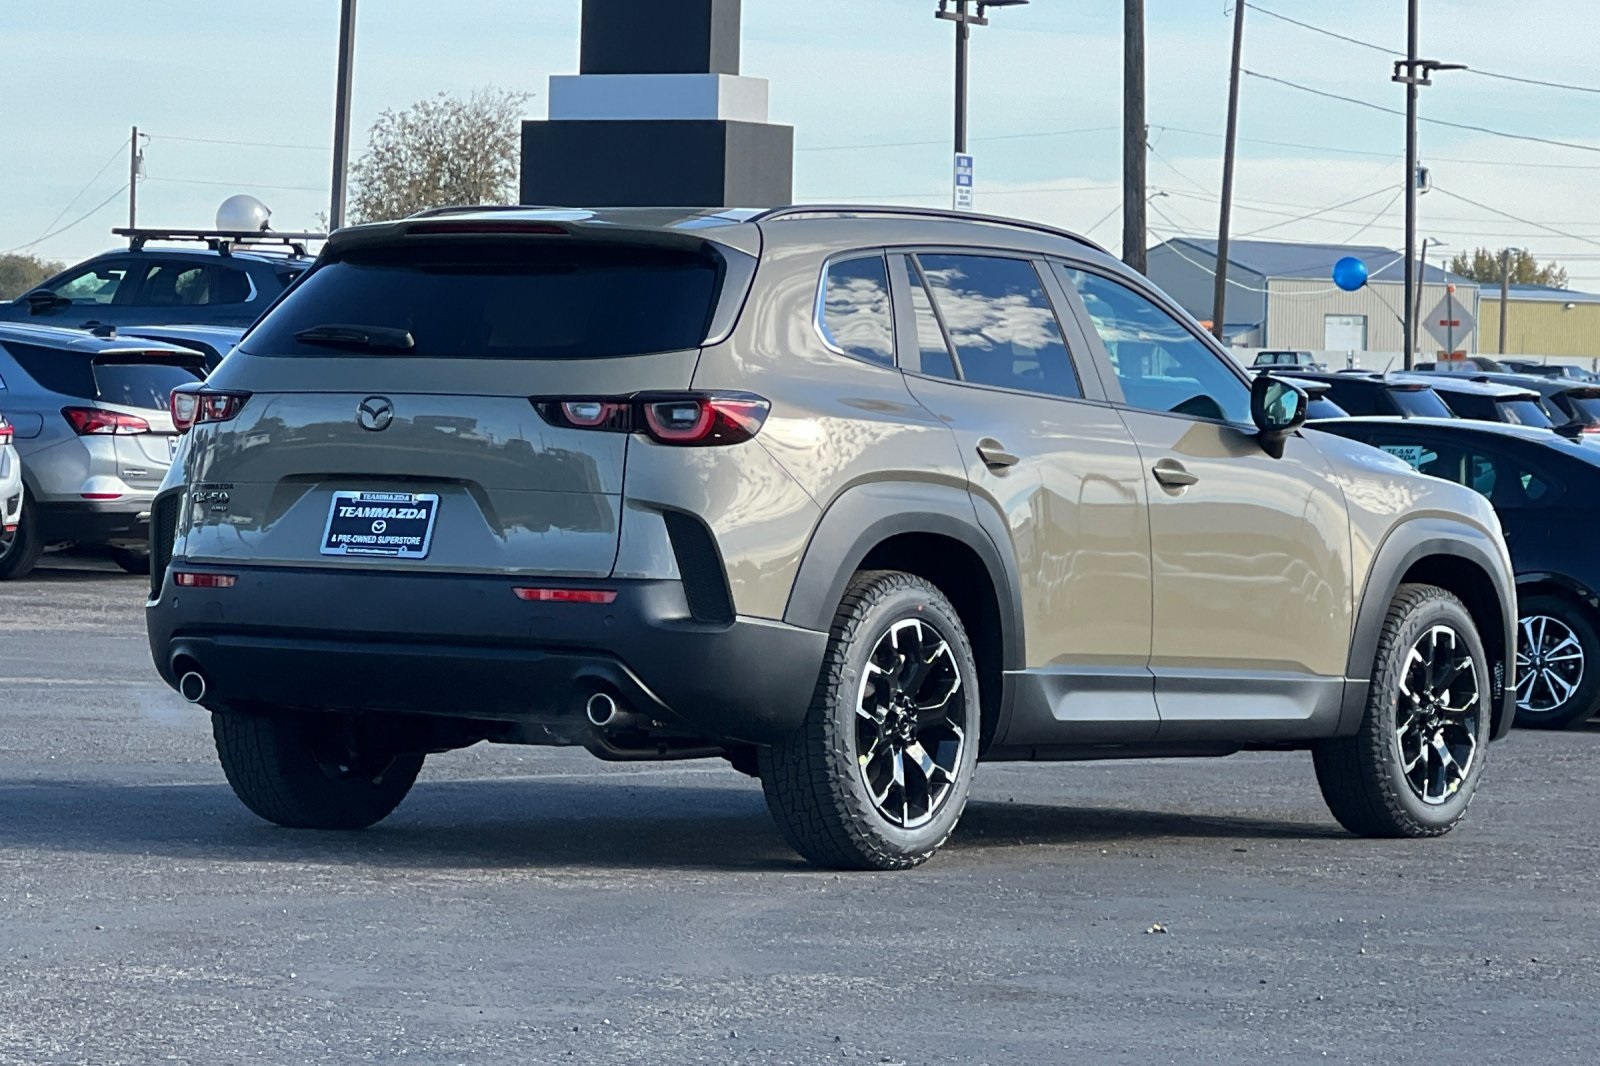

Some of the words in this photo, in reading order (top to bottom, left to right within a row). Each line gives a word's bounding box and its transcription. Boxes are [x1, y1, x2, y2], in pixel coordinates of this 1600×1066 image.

[192, 491, 230, 503] CX-50
[339, 506, 427, 520] TEAMMAZDA
[337, 534, 376, 544] PRE-OWNED
[376, 537, 421, 545] SUPERSTORE
